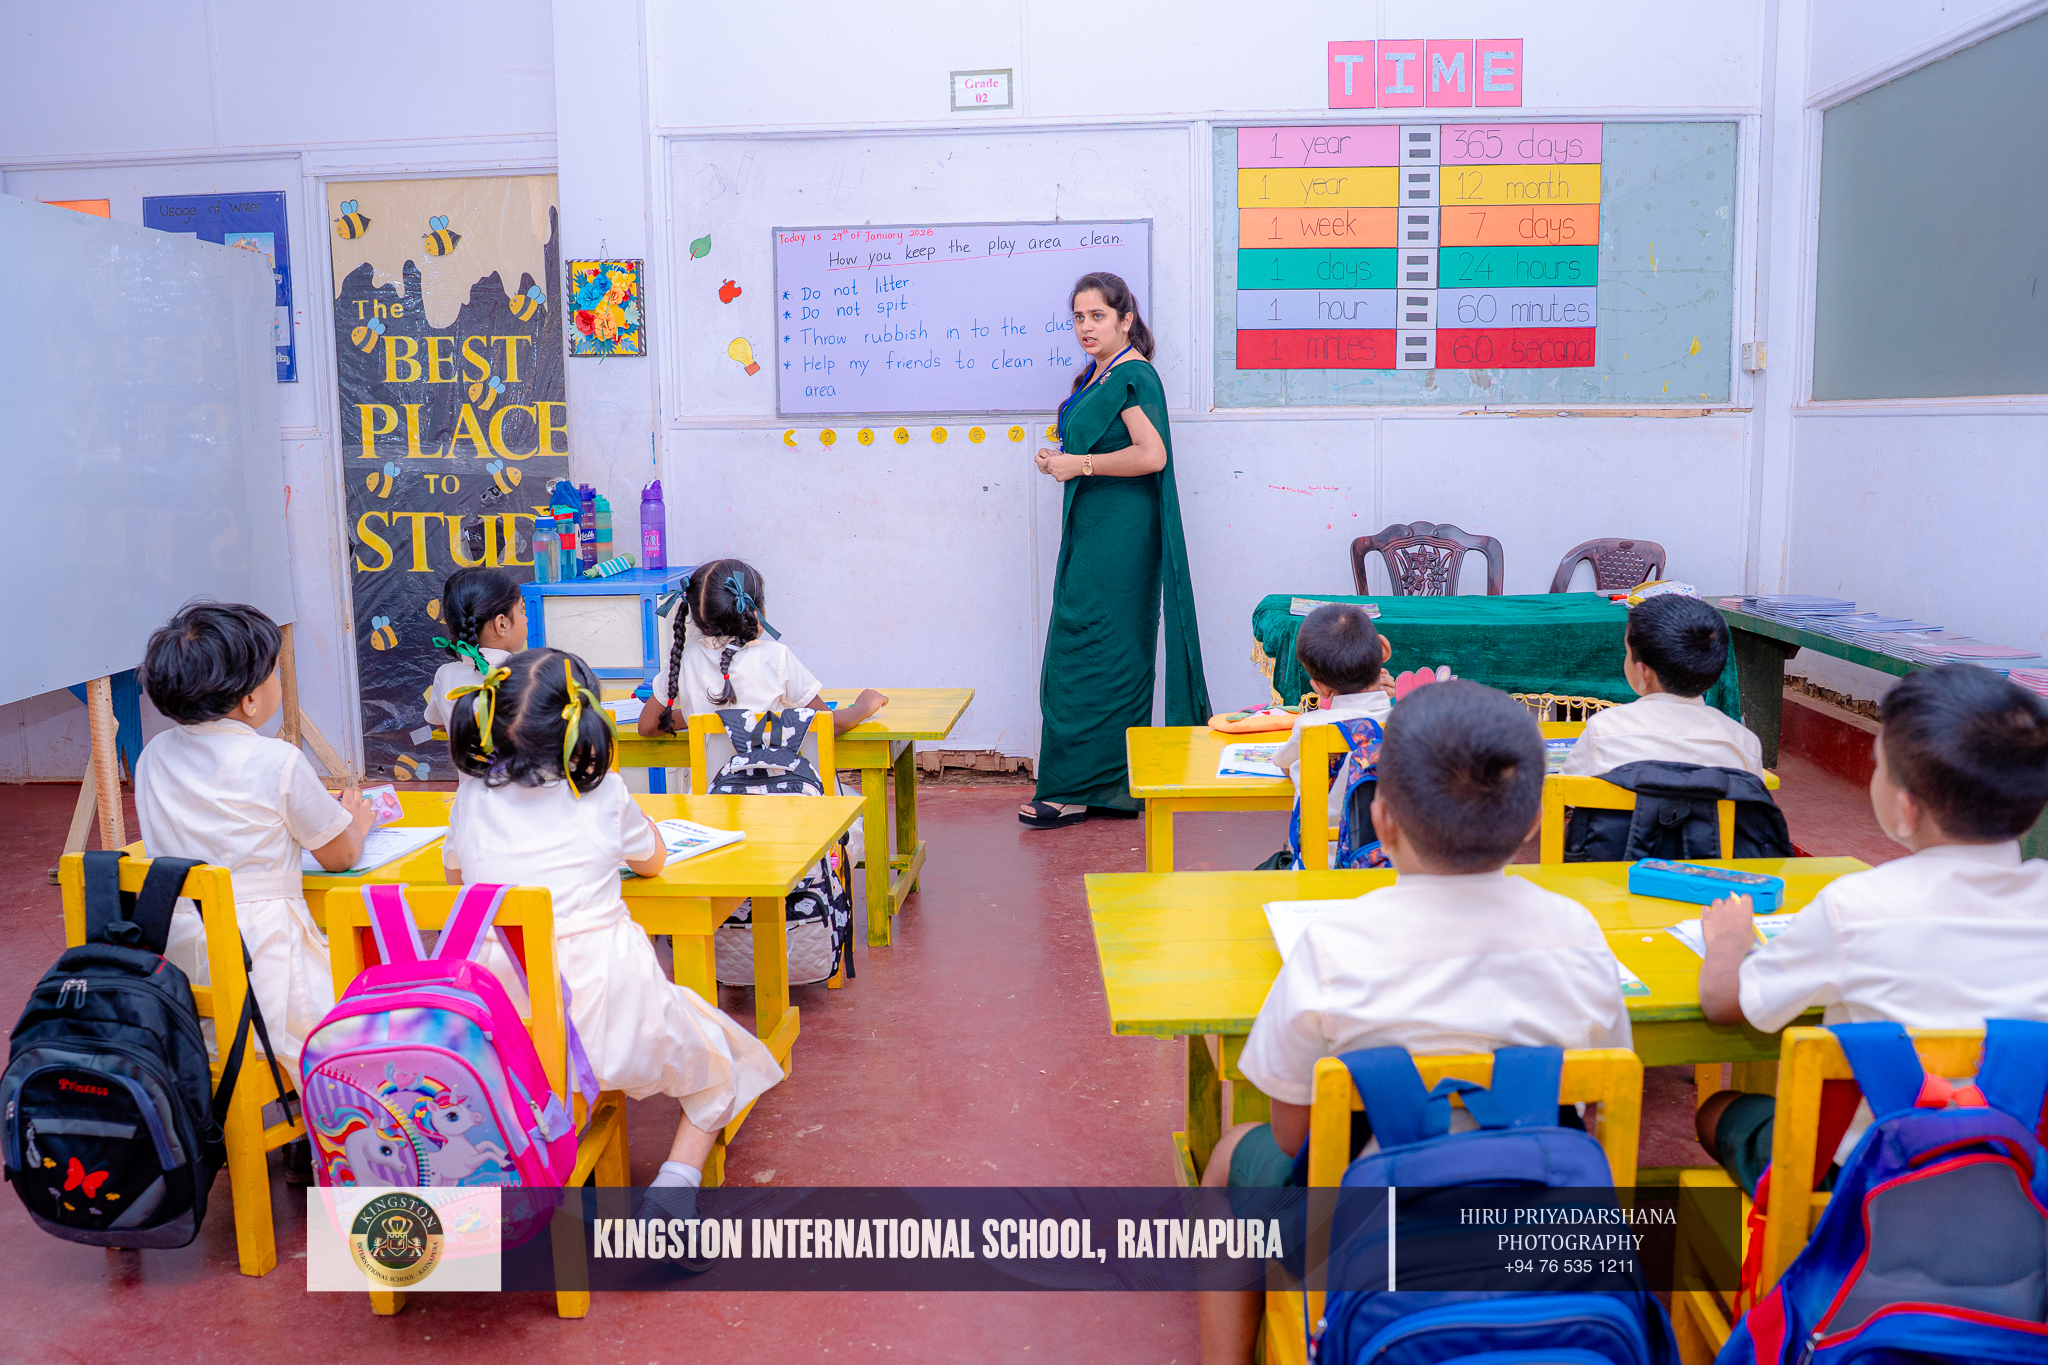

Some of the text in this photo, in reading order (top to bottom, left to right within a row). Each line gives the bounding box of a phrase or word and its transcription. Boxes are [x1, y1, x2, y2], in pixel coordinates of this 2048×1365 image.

[964, 78, 999, 89] Grade
[1334, 51, 1514, 95] TIME
[975, 93, 988, 103] 02
[1270, 128, 1583, 166] 1 year 365 days
[1259, 170, 1569, 204] 1 year 12 month
[160, 204, 198, 224] Usage
[208, 200, 221, 215] of
[1268, 208, 1575, 245] 1 week 7 days
[779, 233, 806, 247] Today
[813, 232, 822, 241] is
[850, 231, 861, 240] of
[865, 230, 903, 245] January
[829, 252, 857, 267] How
[868, 252, 892, 270] you
[905, 244, 936, 260] keep
[949, 239, 971, 253] the
[988, 235, 1015, 258] play
[1028, 237, 1062, 249] area
[1271, 252, 1581, 288] 1 days 24 hours
[801, 287, 821, 301] Do
[834, 279, 859, 297] not
[353, 299, 404, 319] The
[801, 306, 820, 320] Do
[837, 301, 861, 317] not
[1269, 292, 1590, 323] 1 hour 60 minutes
[800, 313, 1074, 346] Throw rubbish in to the dus
[381, 335, 532, 383] BEST
[804, 355, 836, 375] Help
[849, 359, 870, 376] my
[886, 349, 941, 370] friends
[955, 349, 976, 369] to
[991, 349, 1033, 369] clean
[1047, 347, 1073, 367] the
[1269, 338, 1283, 360] 1
[1454, 335, 1494, 363] 60
[1511, 330, 1591, 363] second
[354, 401, 569, 460] PLACE
[824, 432, 831, 443] 2
[863, 432, 869, 442] 3
[935, 430, 943, 440] 5
[973, 430, 981, 441] 6
[1011, 429, 1019, 440] 7
[424, 474, 460, 494] TO
[356, 506, 552, 573] STUD
[58, 1078, 108, 1096] Princess
